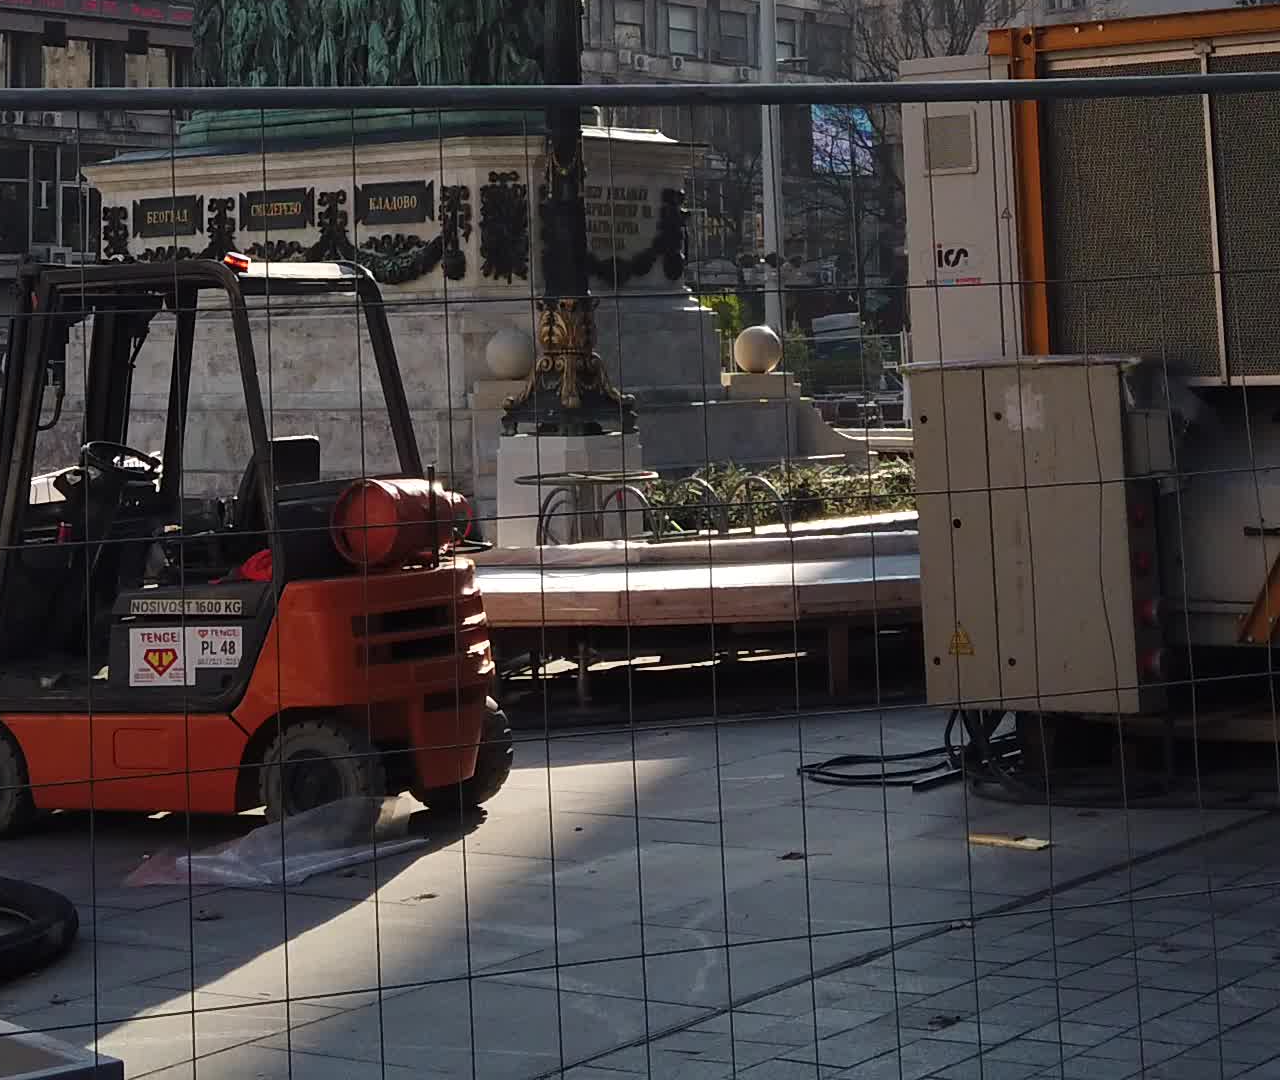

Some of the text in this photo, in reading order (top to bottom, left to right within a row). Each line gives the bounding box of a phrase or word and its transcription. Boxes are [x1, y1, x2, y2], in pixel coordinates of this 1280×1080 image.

[131, 600, 241, 613] NOSIVOST 1600 KG
[201, 640, 236, 656] PL 48
